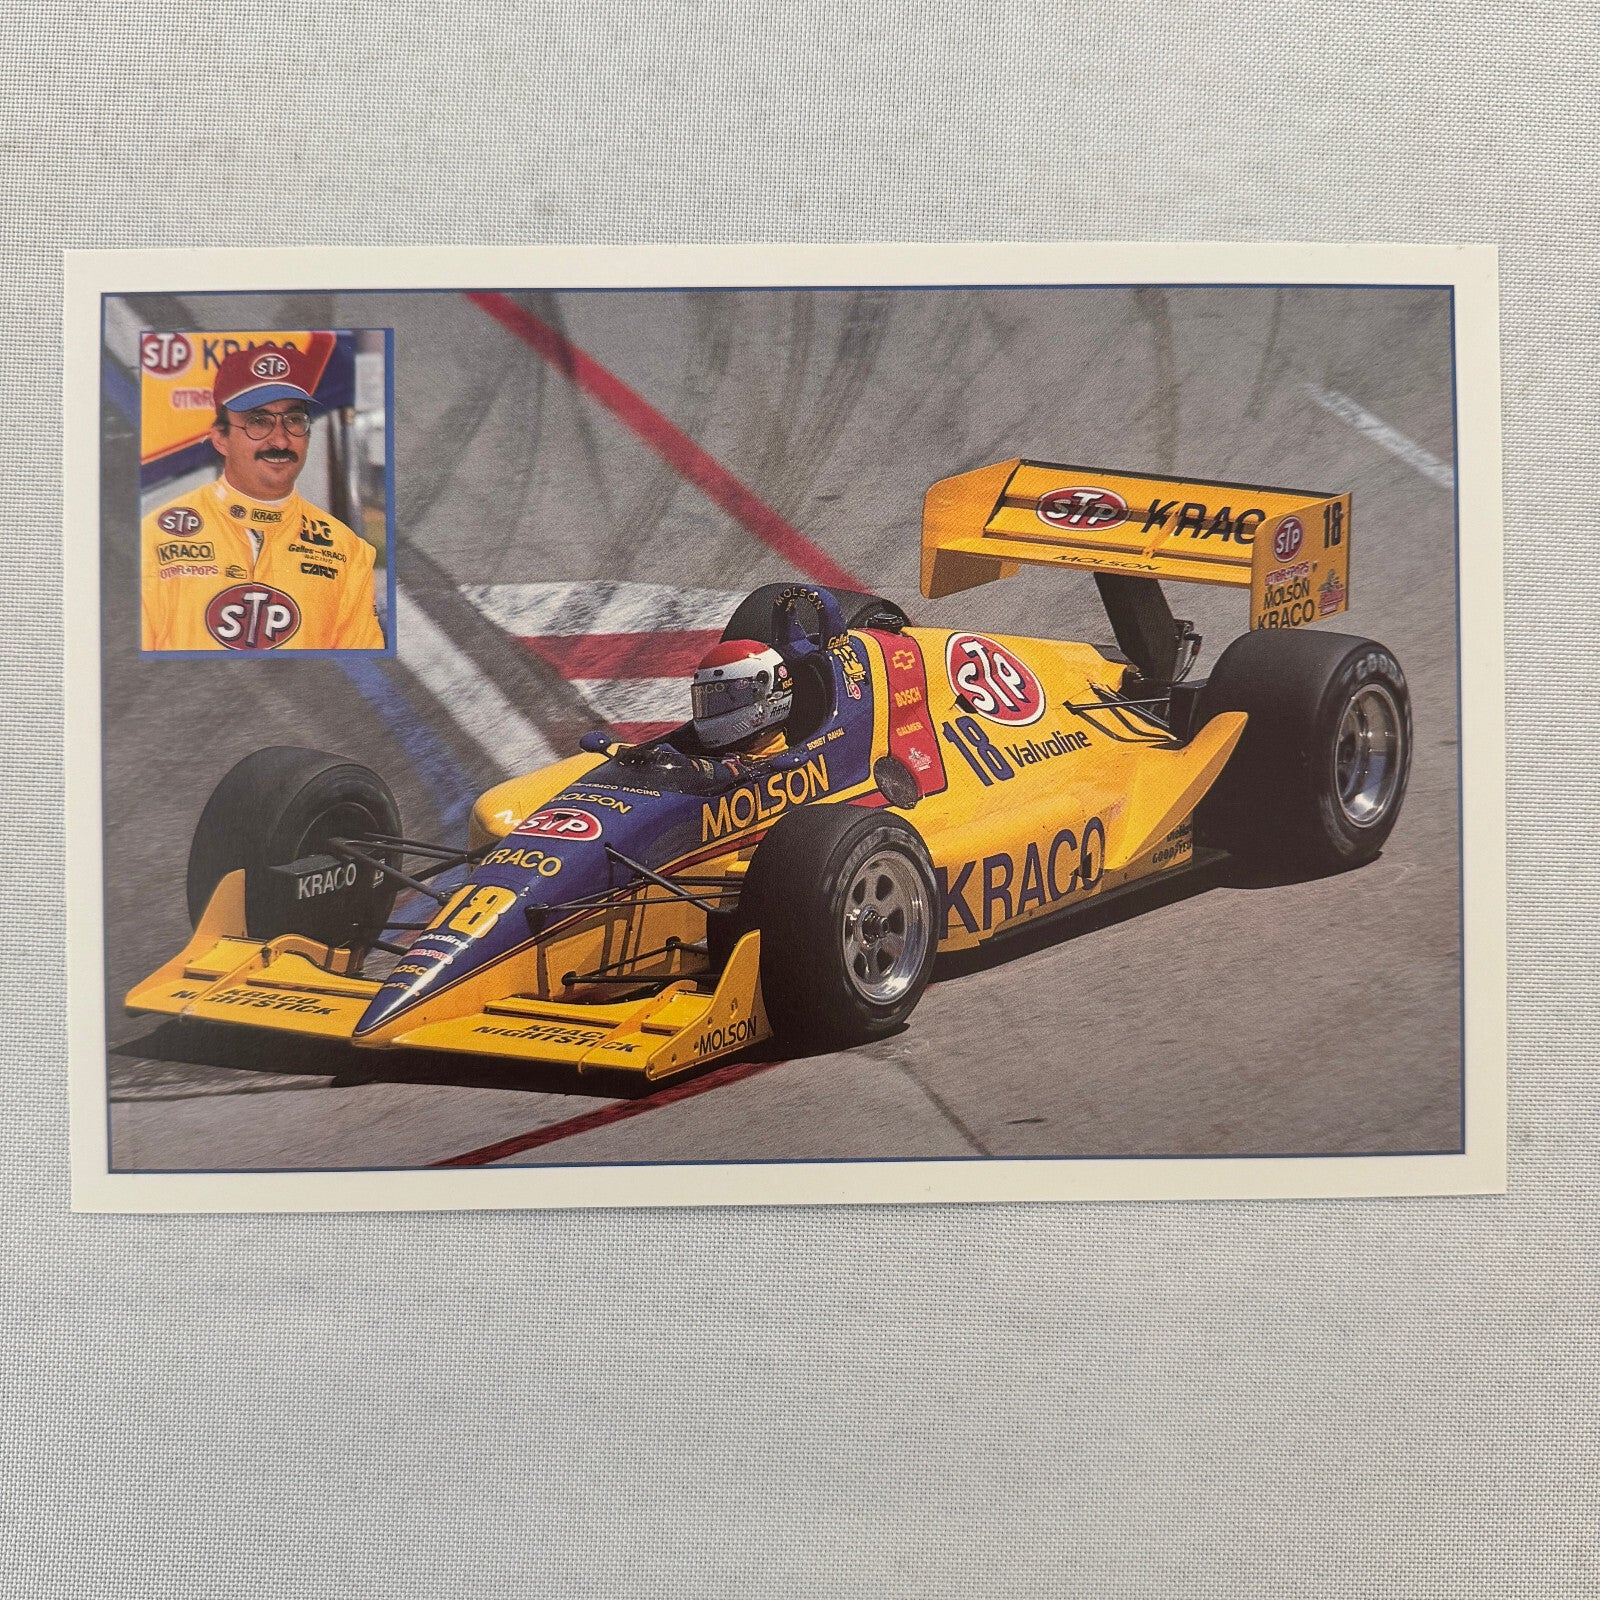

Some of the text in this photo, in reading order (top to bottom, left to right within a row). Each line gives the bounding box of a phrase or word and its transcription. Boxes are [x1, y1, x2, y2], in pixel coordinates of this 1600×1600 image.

[256, 356, 287, 376] STP
[162, 510, 200, 533] STP
[1046, 491, 1119, 526] STP
[1323, 501, 1344, 549] 18
[159, 544, 212, 562] KRACO
[1275, 521, 1301, 555] STP
[301, 562, 339, 580] CART
[1052, 554, 1161, 572] MOLSON
[1263, 577, 1310, 611] MOLSON
[216, 591, 292, 648] STP
[955, 639, 1030, 715] STP
[894, 686, 922, 708] BOSCH
[942, 715, 1015, 787] 18
[1004, 729, 1093, 768] Valvoline
[622, 785, 661, 797] RACING
[701, 753, 830, 843] MOLSON
[298, 862, 357, 900] KRACO
[934, 816, 1106, 941] KRACO
[223, 989, 322, 1005] KRACO
[699, 1014, 757, 1057] MOLSON
